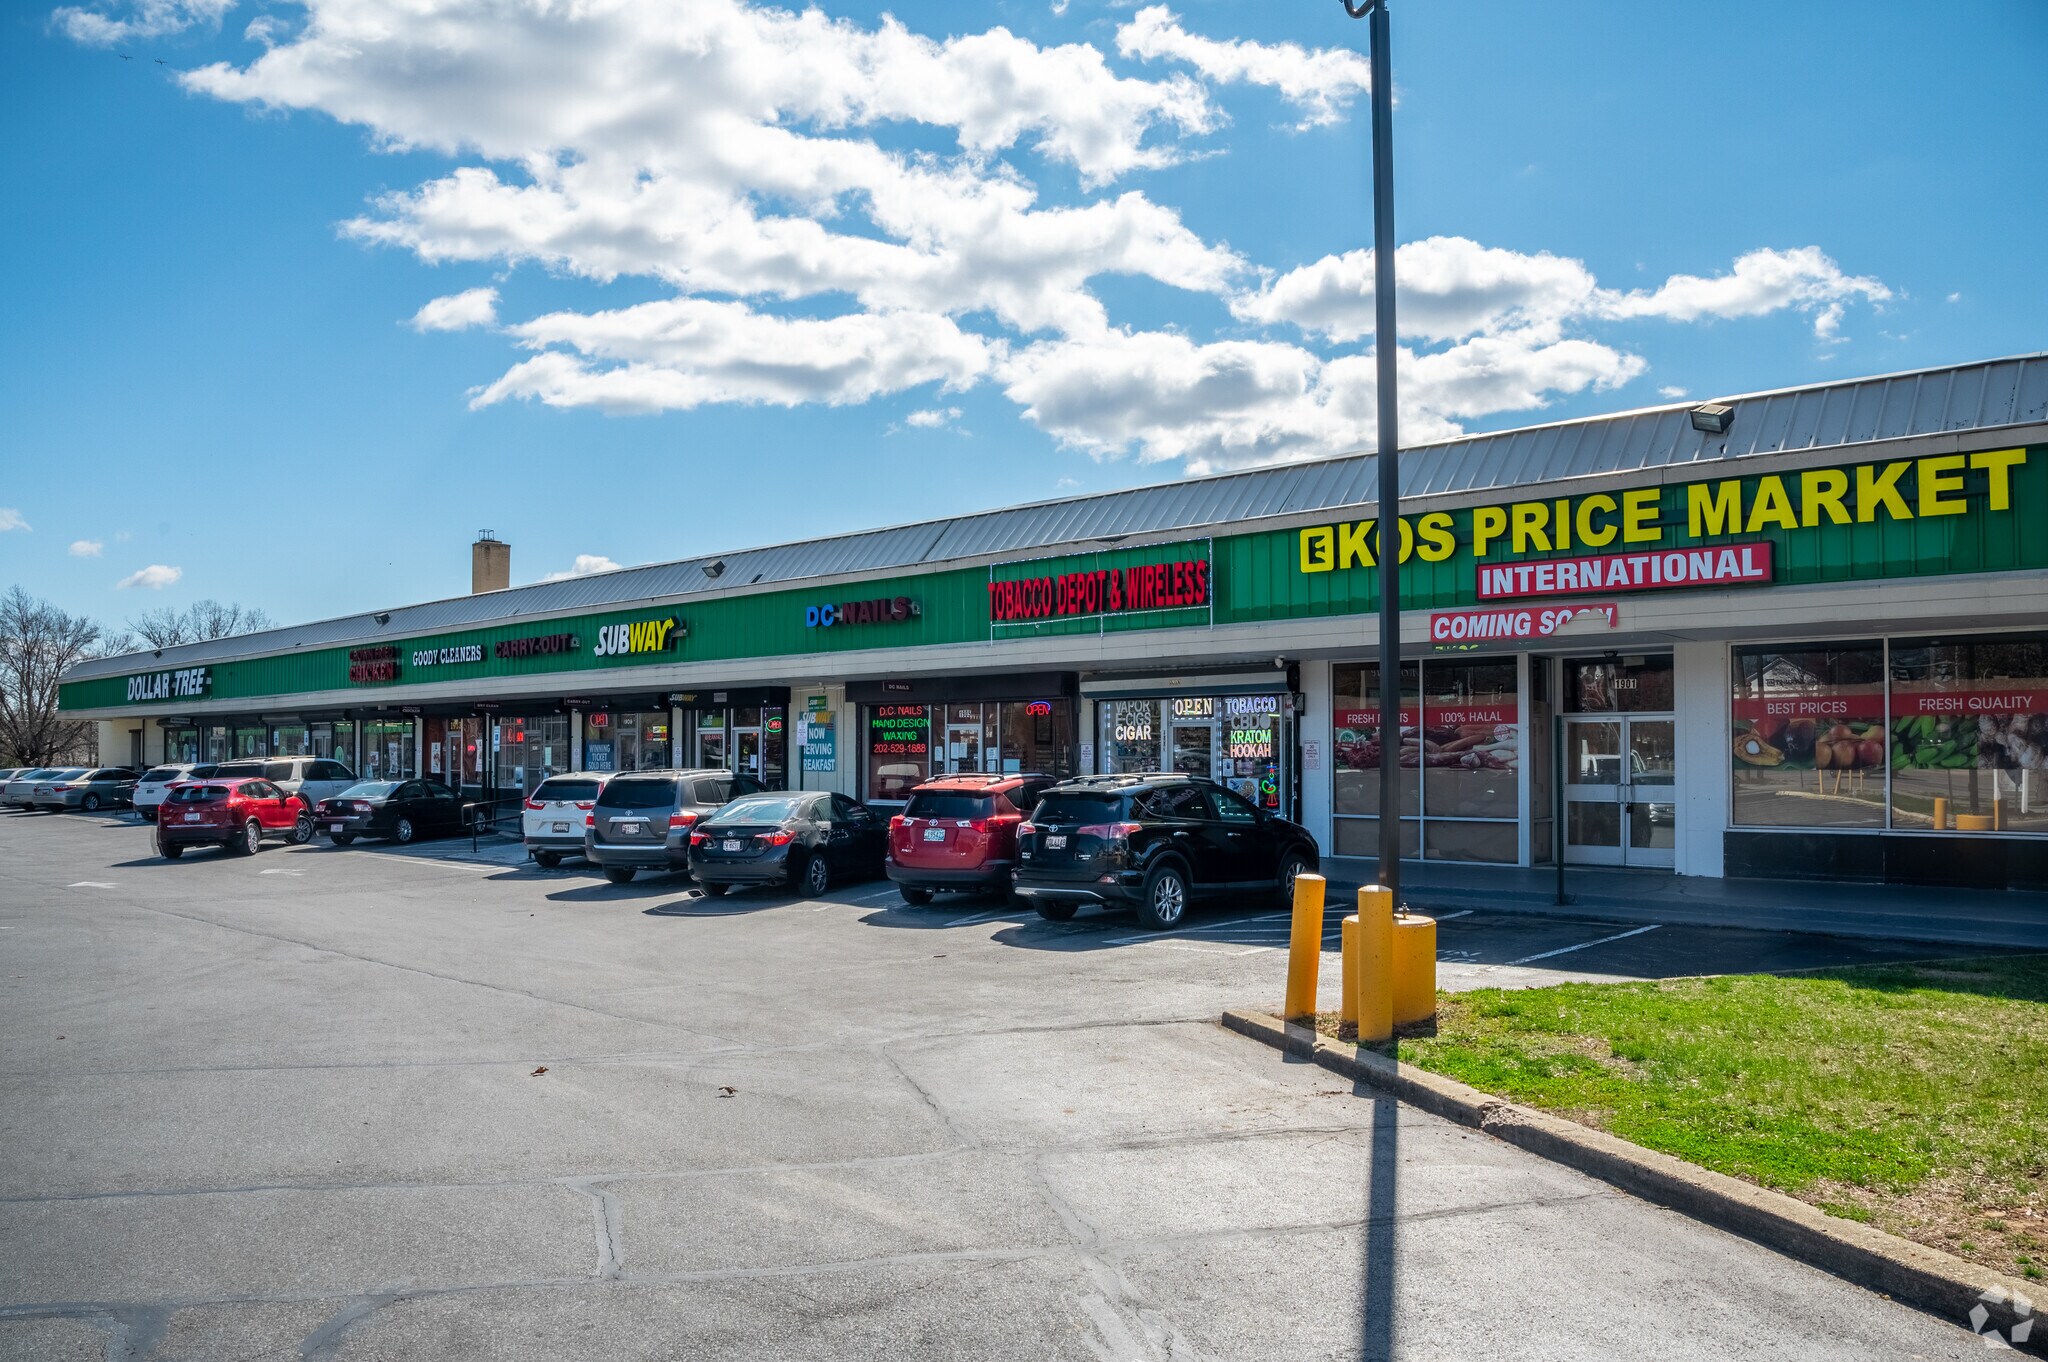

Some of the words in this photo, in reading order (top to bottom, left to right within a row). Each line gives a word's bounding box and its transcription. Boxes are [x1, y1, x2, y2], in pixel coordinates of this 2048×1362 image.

[1473, 488, 1662, 557] PRICE
[1687, 448, 2027, 538] MARKET
[1482, 547, 1763, 595] INTERNATIONAL
[987, 576, 1054, 621] TOBACCO
[1057, 570, 1107, 616] DEPOT
[1109, 568, 1122, 611] &
[1126, 560, 1208, 609] WIRELESS
[806, 604, 834, 628] DC
[842, 597, 908, 625] NAILS
[1434, 611, 1532, 639] COMING
[594, 618, 674, 657] SUBWAY
[494, 634, 569, 659] CARRY-OUT
[413, 649, 438, 666] GOODY
[440, 645, 482, 664] CLEANERS
[350, 662, 394, 681] CHICKEN
[127, 673, 170, 701] DOLLAR
[174, 667, 205, 696] TREE
[1615, 680, 1636, 688] 1901
[670, 693, 697, 702] SUBWAY
[1919, 699, 1963, 711] FRESH
[1968, 696, 2033, 710] QUALITY
[879, 706, 895, 716] D.C.
[897, 705, 922, 715] NAILS
[1025, 703, 1050, 716] OPEN
[1115, 700, 1151, 714] VAPOR
[1174, 699, 1213, 716] OPEN
[1225, 697, 1276, 714] TOBACCO
[1767, 703, 1796, 715] BEST
[1800, 701, 1847, 714] PRICES
[801, 712, 832, 724] SUBWAY
[873, 719, 896, 728] HAND
[898, 718, 930, 728] DESIGN
[1115, 713, 1152, 726] E-CIGS
[1347, 713, 1374, 724] FRESH
[1440, 712, 1466, 723] 100%
[1469, 711, 1502, 722] HALAL
[808, 727, 826, 740] NOW
[883, 731, 917, 741] WAXING
[1115, 726, 1152, 741] CIGAR
[1230, 729, 1272, 744] KRATOM
[588, 744, 611, 753] WINNING
[874, 743, 926, 754] 202-529-1888
[1230, 743, 1272, 758] HOOKAH
[592, 753, 608, 761] TICKET
[588, 761, 600, 770] SOLD
[600, 761, 612, 770] HERE
[803, 759, 835, 771] REAKFAST
